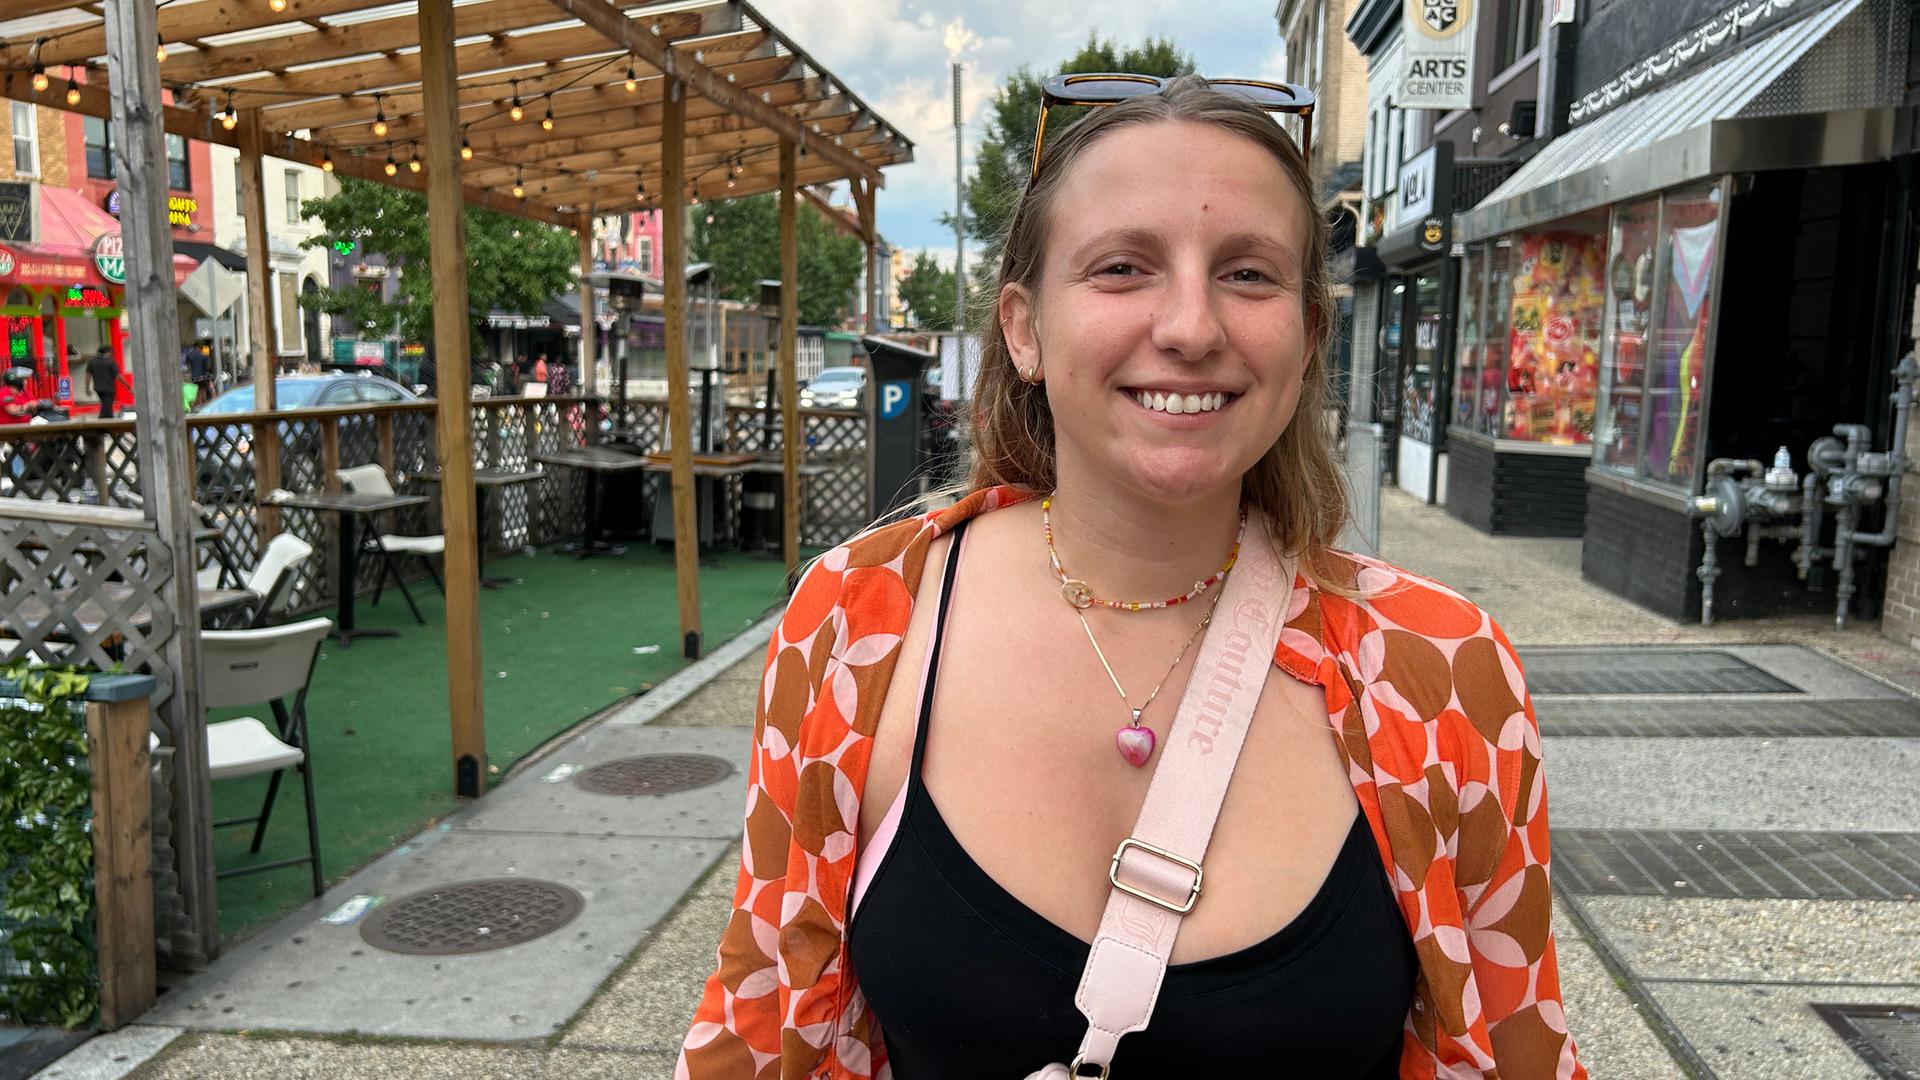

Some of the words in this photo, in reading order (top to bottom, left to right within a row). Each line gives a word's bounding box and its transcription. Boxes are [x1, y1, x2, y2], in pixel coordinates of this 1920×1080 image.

[1409, 59, 1466, 78] ARTS
[1407, 81, 1464, 95] CENTER
[883, 384, 903, 413] P
[1187, 597, 1270, 757] Couture
